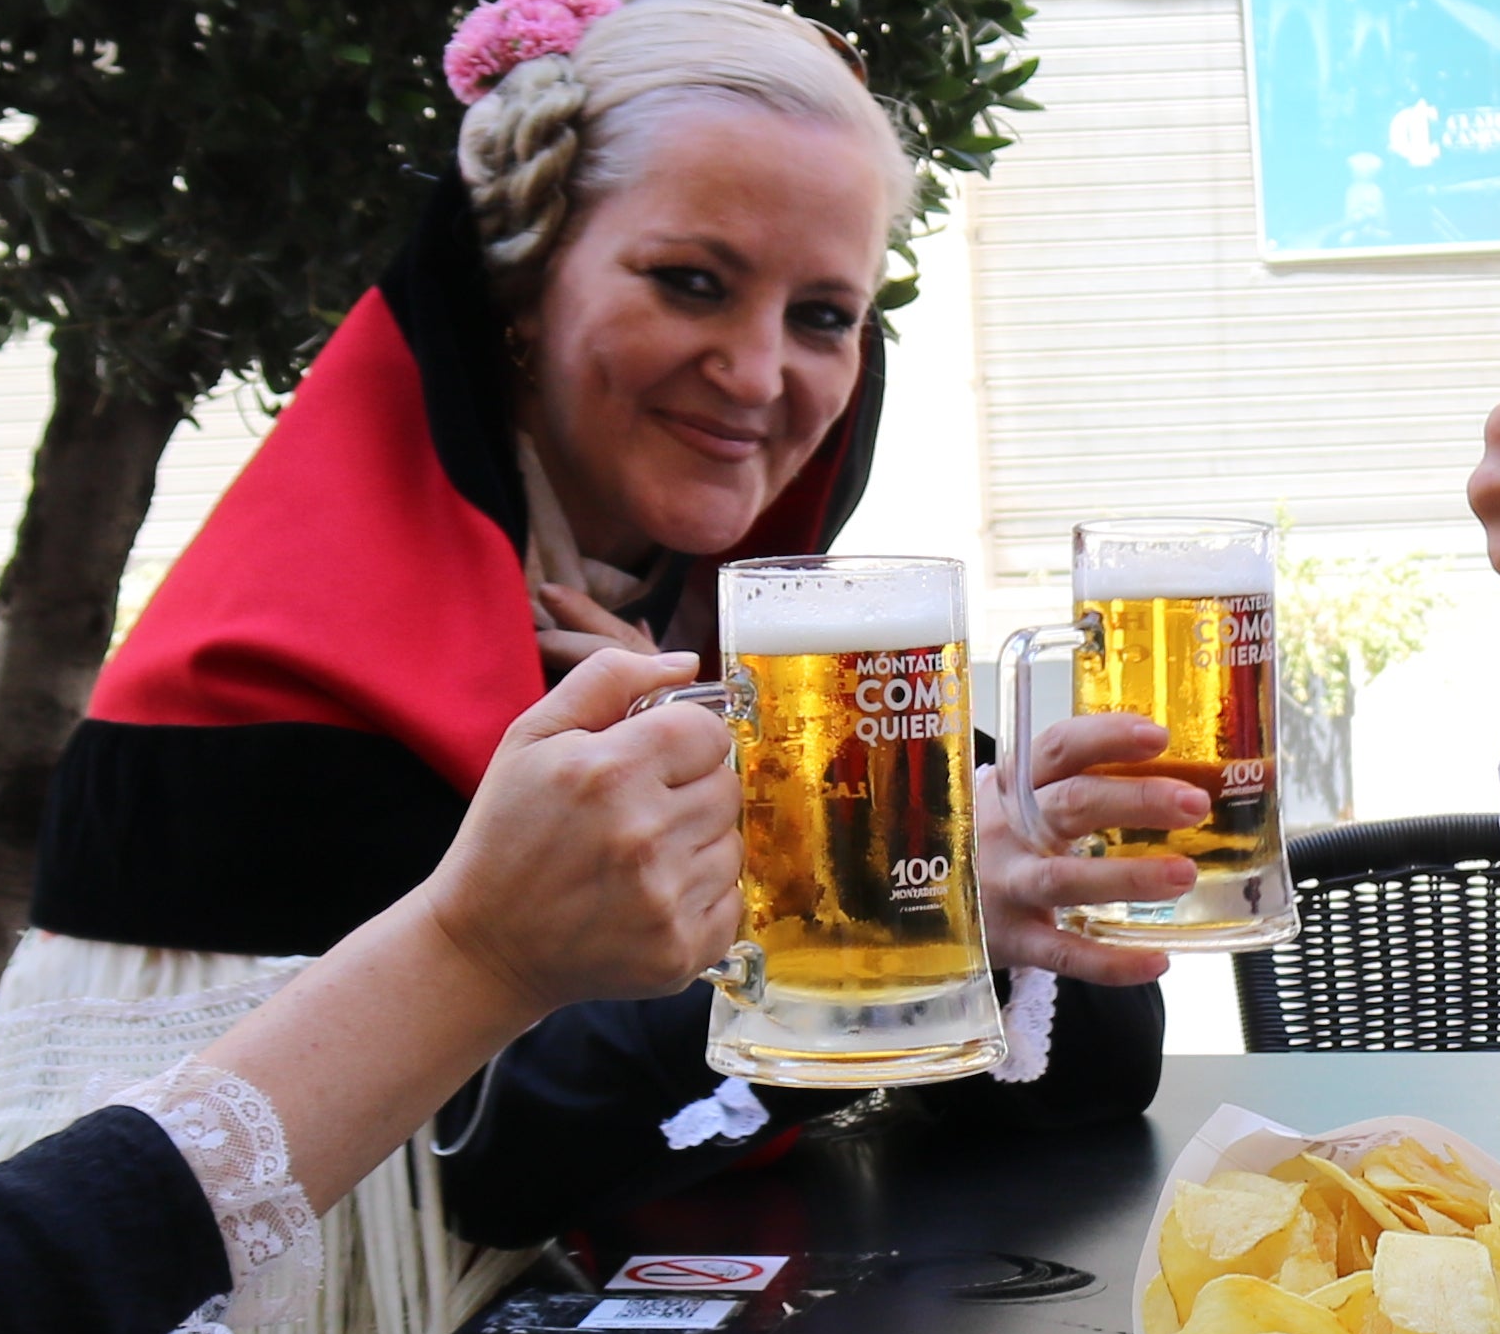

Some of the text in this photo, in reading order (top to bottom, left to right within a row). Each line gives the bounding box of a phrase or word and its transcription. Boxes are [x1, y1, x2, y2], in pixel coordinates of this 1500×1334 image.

[1194, 611, 1273, 644] COMO
[856, 651, 960, 676] MÓNTATELO
[1193, 642, 1273, 669] QUIERAS
[855, 673, 960, 714] COMO
[855, 710, 962, 748] QUIERAS
[1220, 760, 1265, 787] 100
[890, 855, 950, 887] 100
